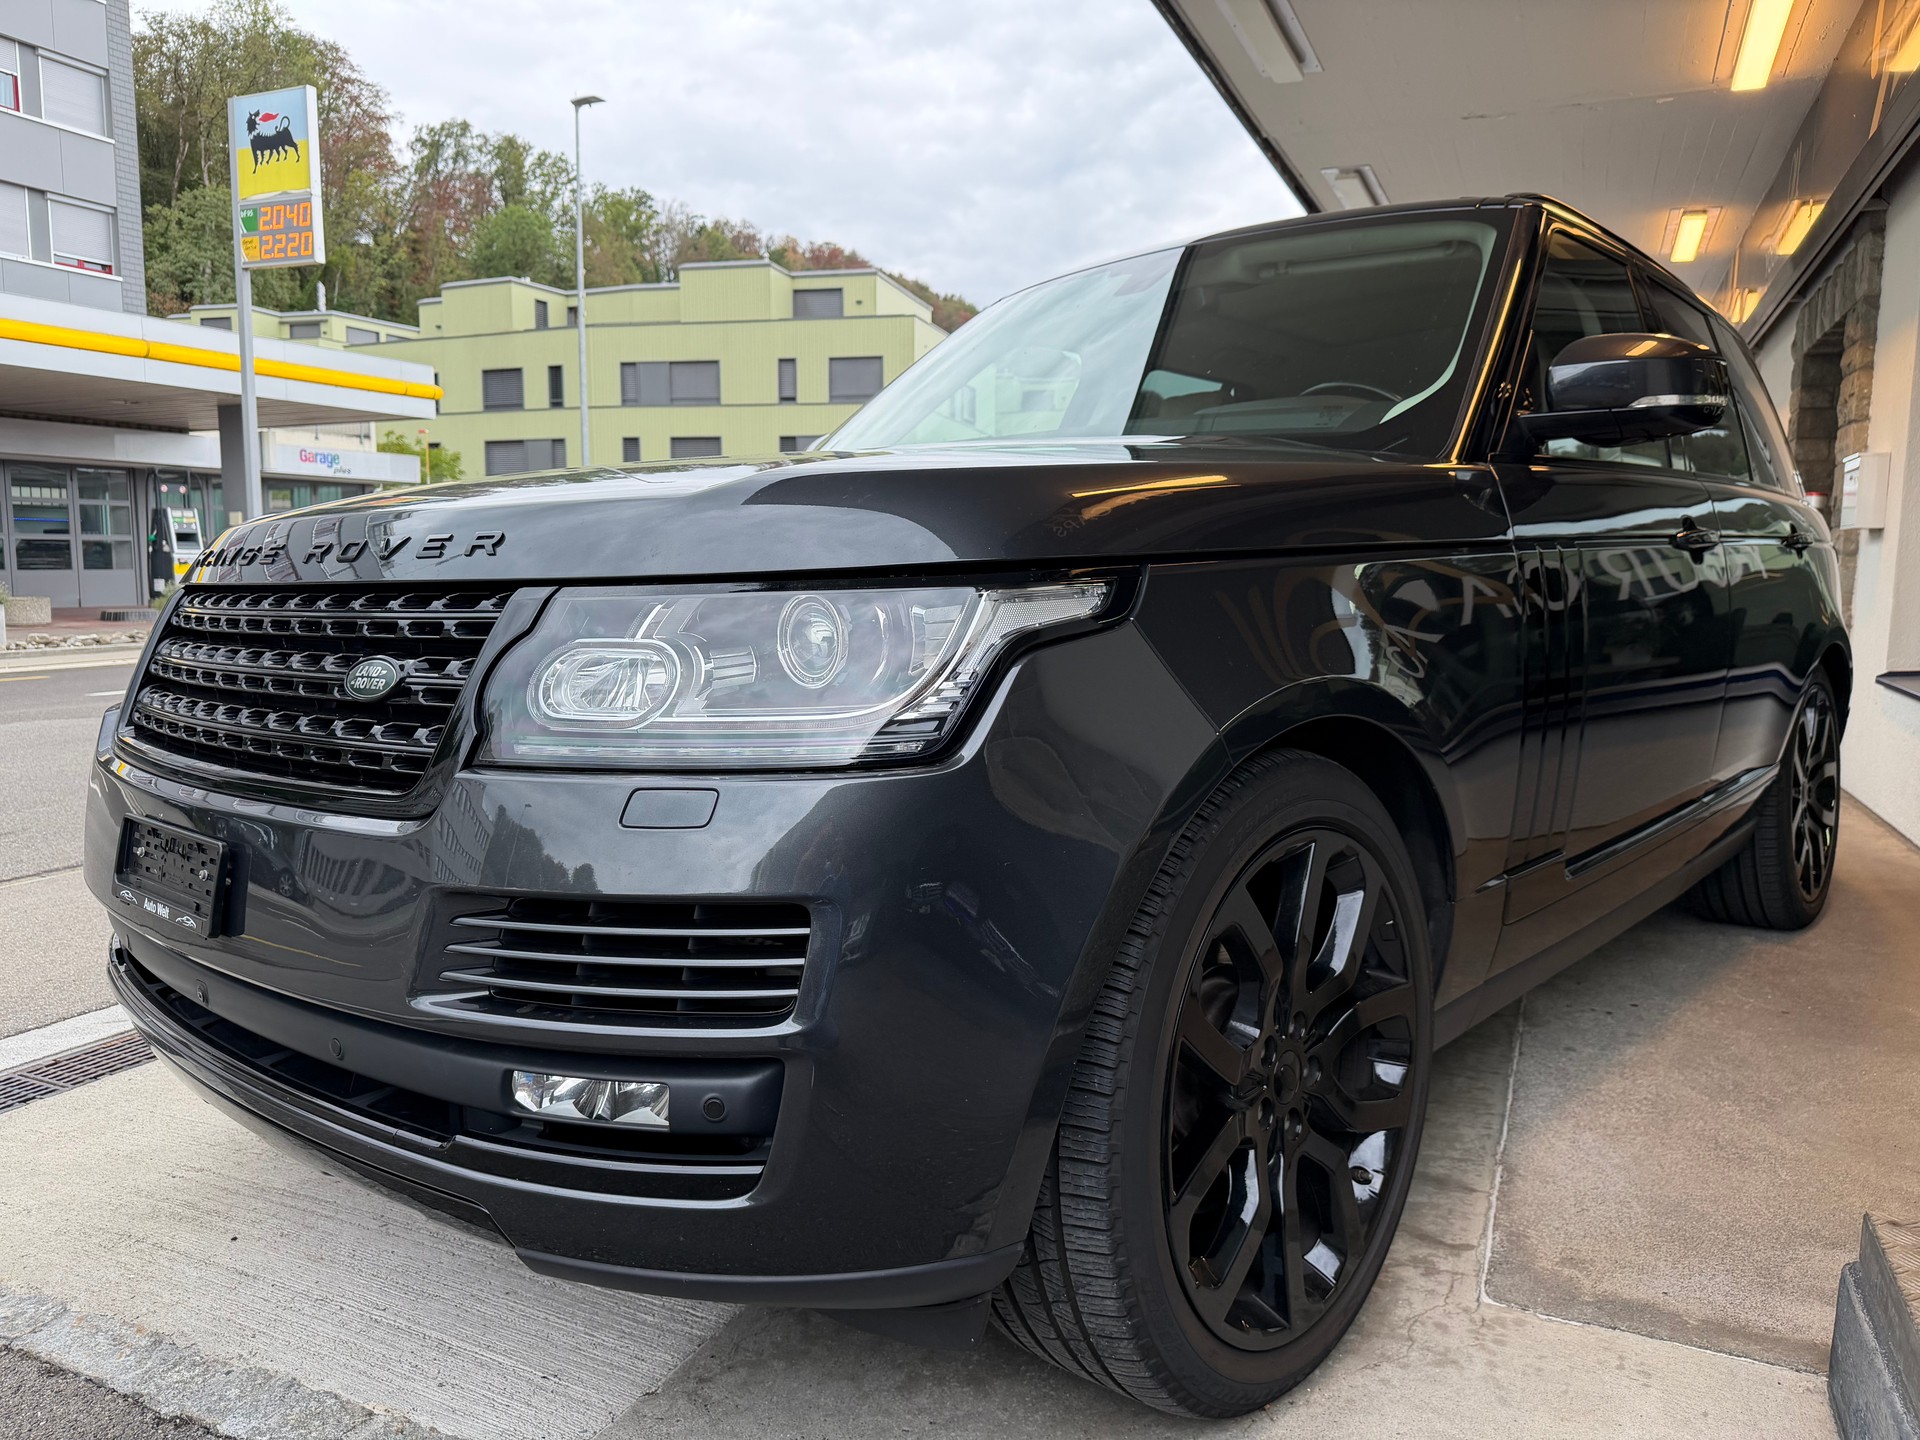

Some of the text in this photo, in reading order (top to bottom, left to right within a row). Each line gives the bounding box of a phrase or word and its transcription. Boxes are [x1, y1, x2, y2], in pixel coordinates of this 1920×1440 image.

[299, 449, 340, 468] Garage
[333, 465, 351, 475] plus
[196, 530, 506, 568] RANGE ROVER
[355, 665, 382, 677] LAND
[353, 677, 386, 690] ROVER
[143, 897, 170, 919] Auto Welt
